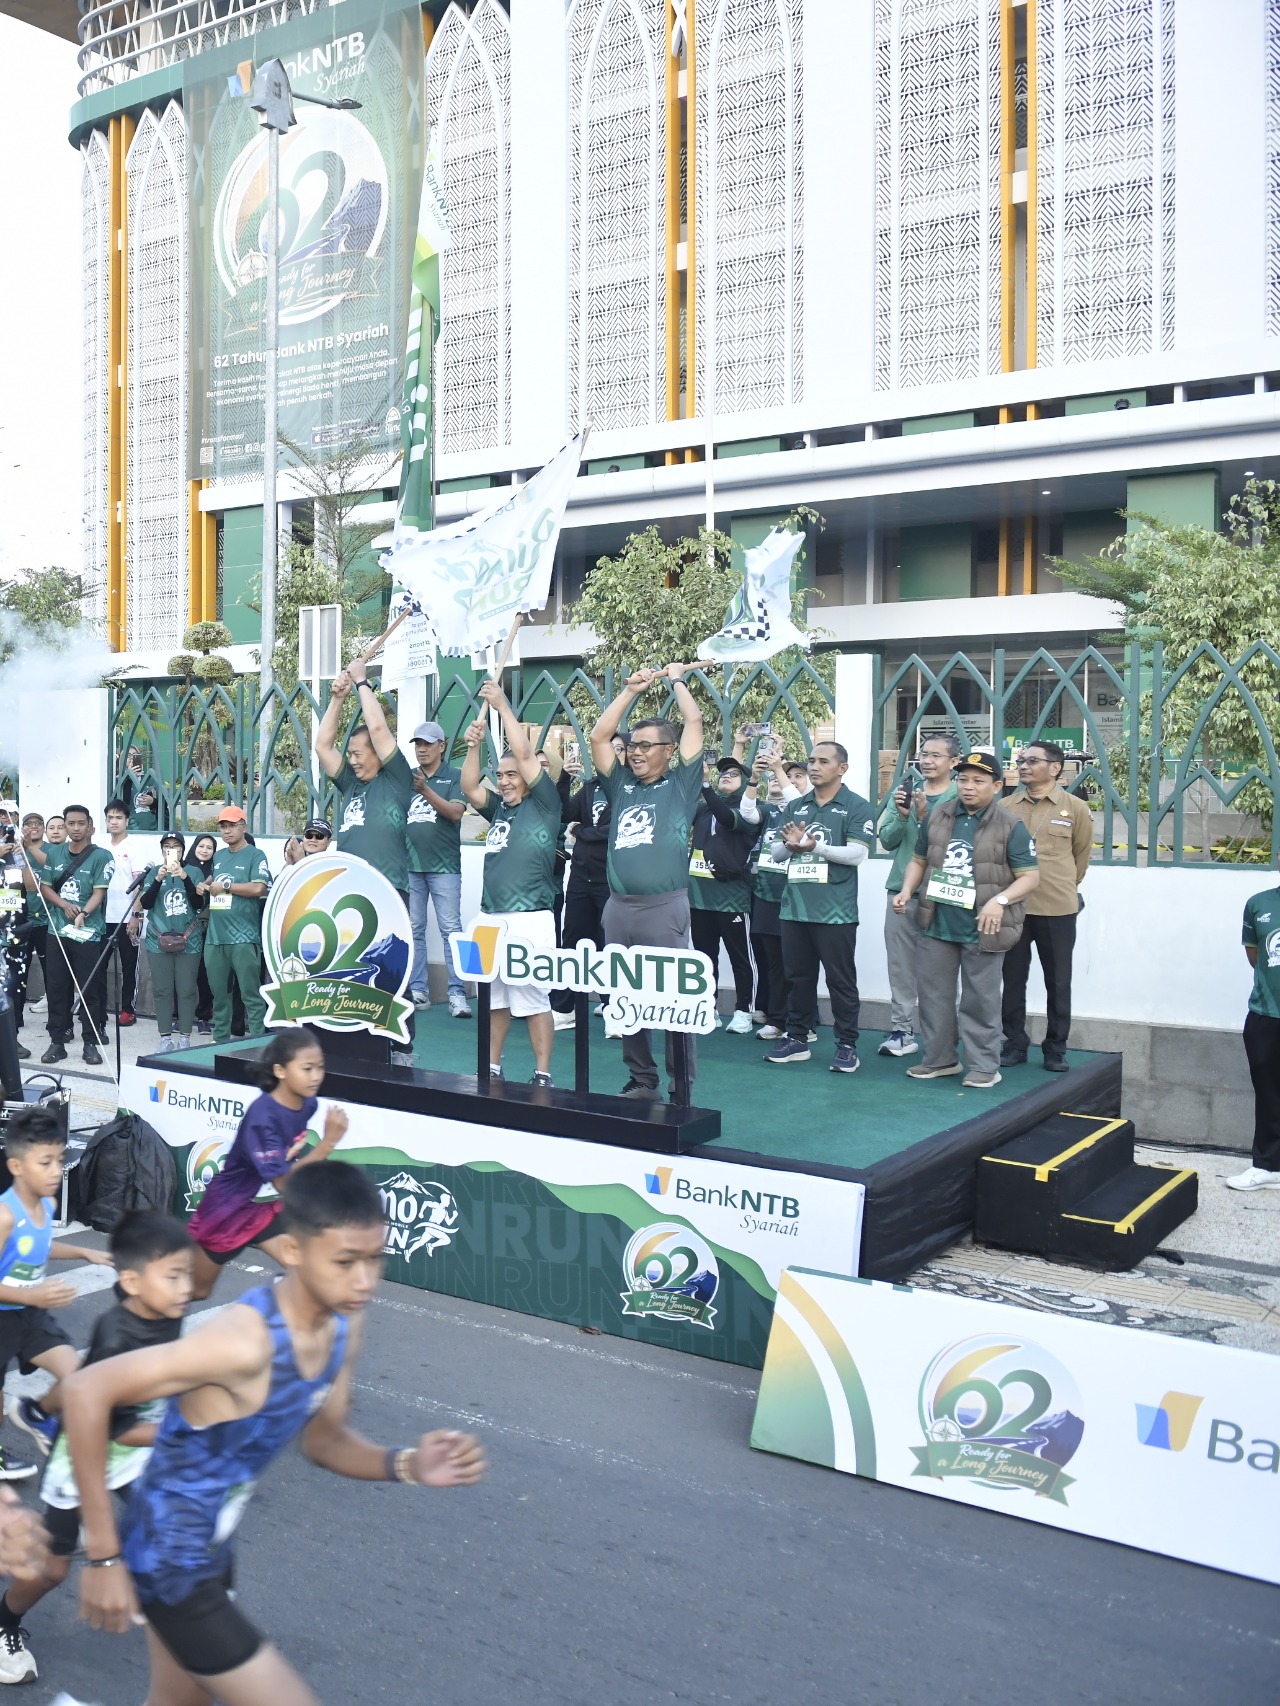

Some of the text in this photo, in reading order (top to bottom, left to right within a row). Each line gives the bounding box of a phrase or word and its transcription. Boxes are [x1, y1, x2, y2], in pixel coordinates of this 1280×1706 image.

[313, 54, 366, 94] Syariah
[214, 355, 230, 369] 62
[307, 335, 334, 354] NTB
[336, 323, 390, 347] Syariah
[293, 365, 306, 376] NTB
[797, 866, 817, 874] 4124
[939, 886, 964, 898] 4130
[280, 867, 379, 972] 62
[506, 943, 708, 995] BankNTB
[306, 981, 351, 998] Ready for
[290, 994, 384, 1020] a Long Journey
[610, 995, 708, 1029] Syariah
[168, 1089, 245, 1118] BankNTB
[675, 1178, 801, 1219] BankNTB
[739, 1214, 800, 1238] Syariah
[633, 1231, 699, 1289] 62
[646, 1298, 666, 1310] Long
[667, 1300, 701, 1316] Journey
[650, 1292, 670, 1302] Ready
[933, 1345, 1053, 1438] 62
[959, 1444, 1012, 1462] Ready for
[937, 1455, 1049, 1487] a Long Journey
